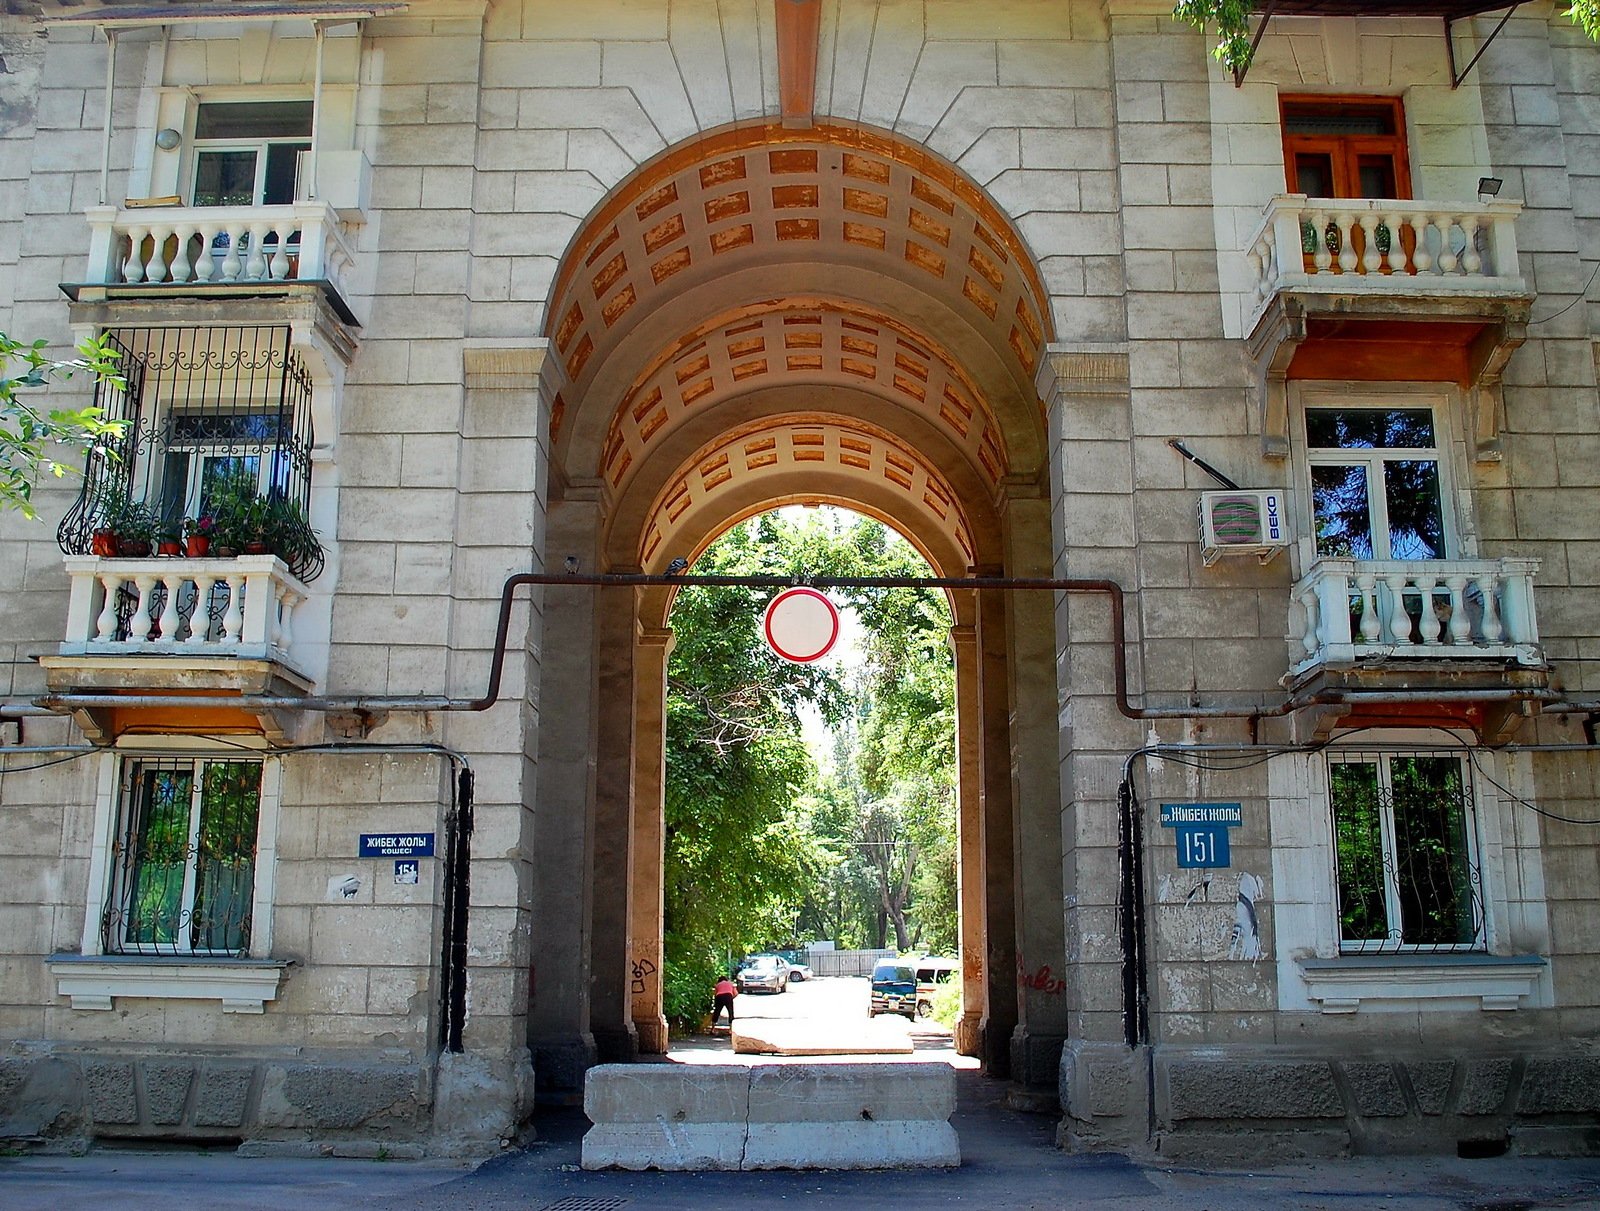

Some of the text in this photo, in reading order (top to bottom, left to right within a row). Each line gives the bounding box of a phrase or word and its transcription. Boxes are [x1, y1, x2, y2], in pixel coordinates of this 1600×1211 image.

[1267, 496, 1279, 539] BEKO
[1172, 807, 1208, 821] ЖИБЕК
[367, 837, 426, 847] ЖИБЕК ЖОЛЫ
[1185, 832, 1215, 862] 151
